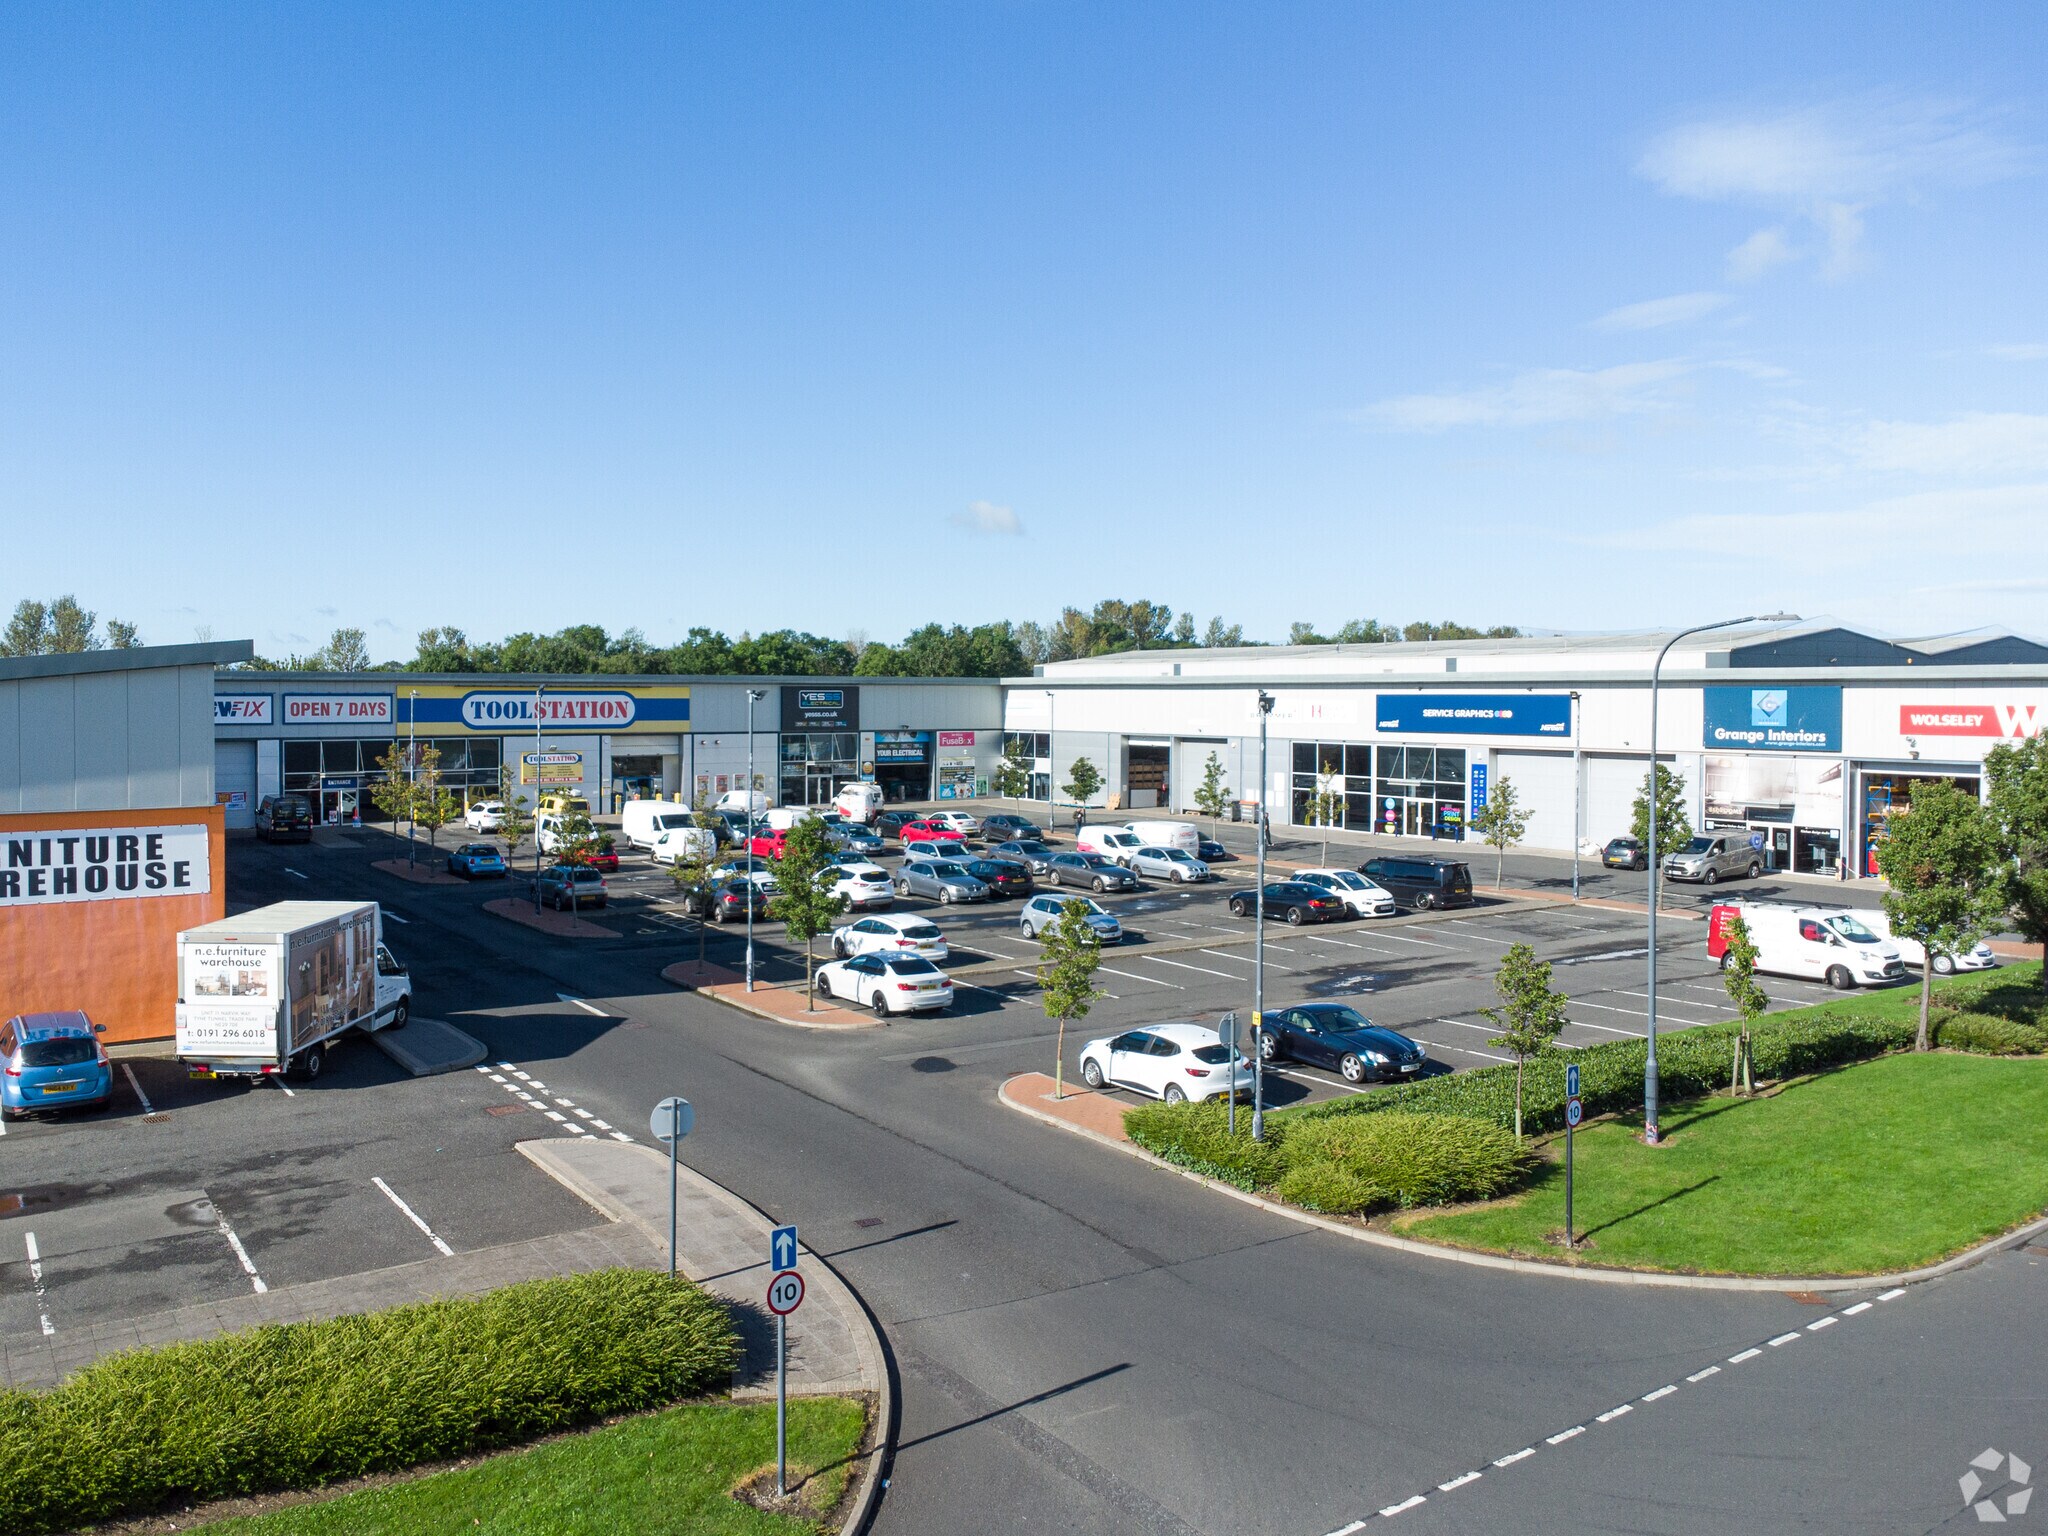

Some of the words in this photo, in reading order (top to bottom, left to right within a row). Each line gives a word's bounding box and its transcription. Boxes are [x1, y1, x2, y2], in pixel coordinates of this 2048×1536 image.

[290, 702, 330, 717] OPEN
[335, 702, 344, 717] 7
[348, 702, 387, 717] DAYS
[470, 700, 629, 719] TOOLSTATION
[804, 711, 838, 719] yesss.co.uk
[1422, 709, 1454, 718] SERVICE
[1454, 709, 1494, 718] GRAPHICS
[1910, 714, 1983, 727] WOLSELEY
[1714, 728, 1765, 743] Grange
[1767, 729, 1827, 742] Interiors
[529, 755, 577, 763] TOOLSTATION
[877, 749, 891, 757] YOUR
[893, 749, 924, 757] ELECTRICAL
[8, 834, 164, 868] NITURE
[0, 861, 191, 898] REHOUSE
[195, 945, 267, 956] n.e.furniture
[200, 957, 262, 967] warehouse
[197, 1029, 219, 1037] 0191
[222, 1029, 240, 1037] 296
[242, 1029, 266, 1038] 6018
[1569, 1106, 1580, 1119] 10
[775, 1283, 797, 1304] 10
